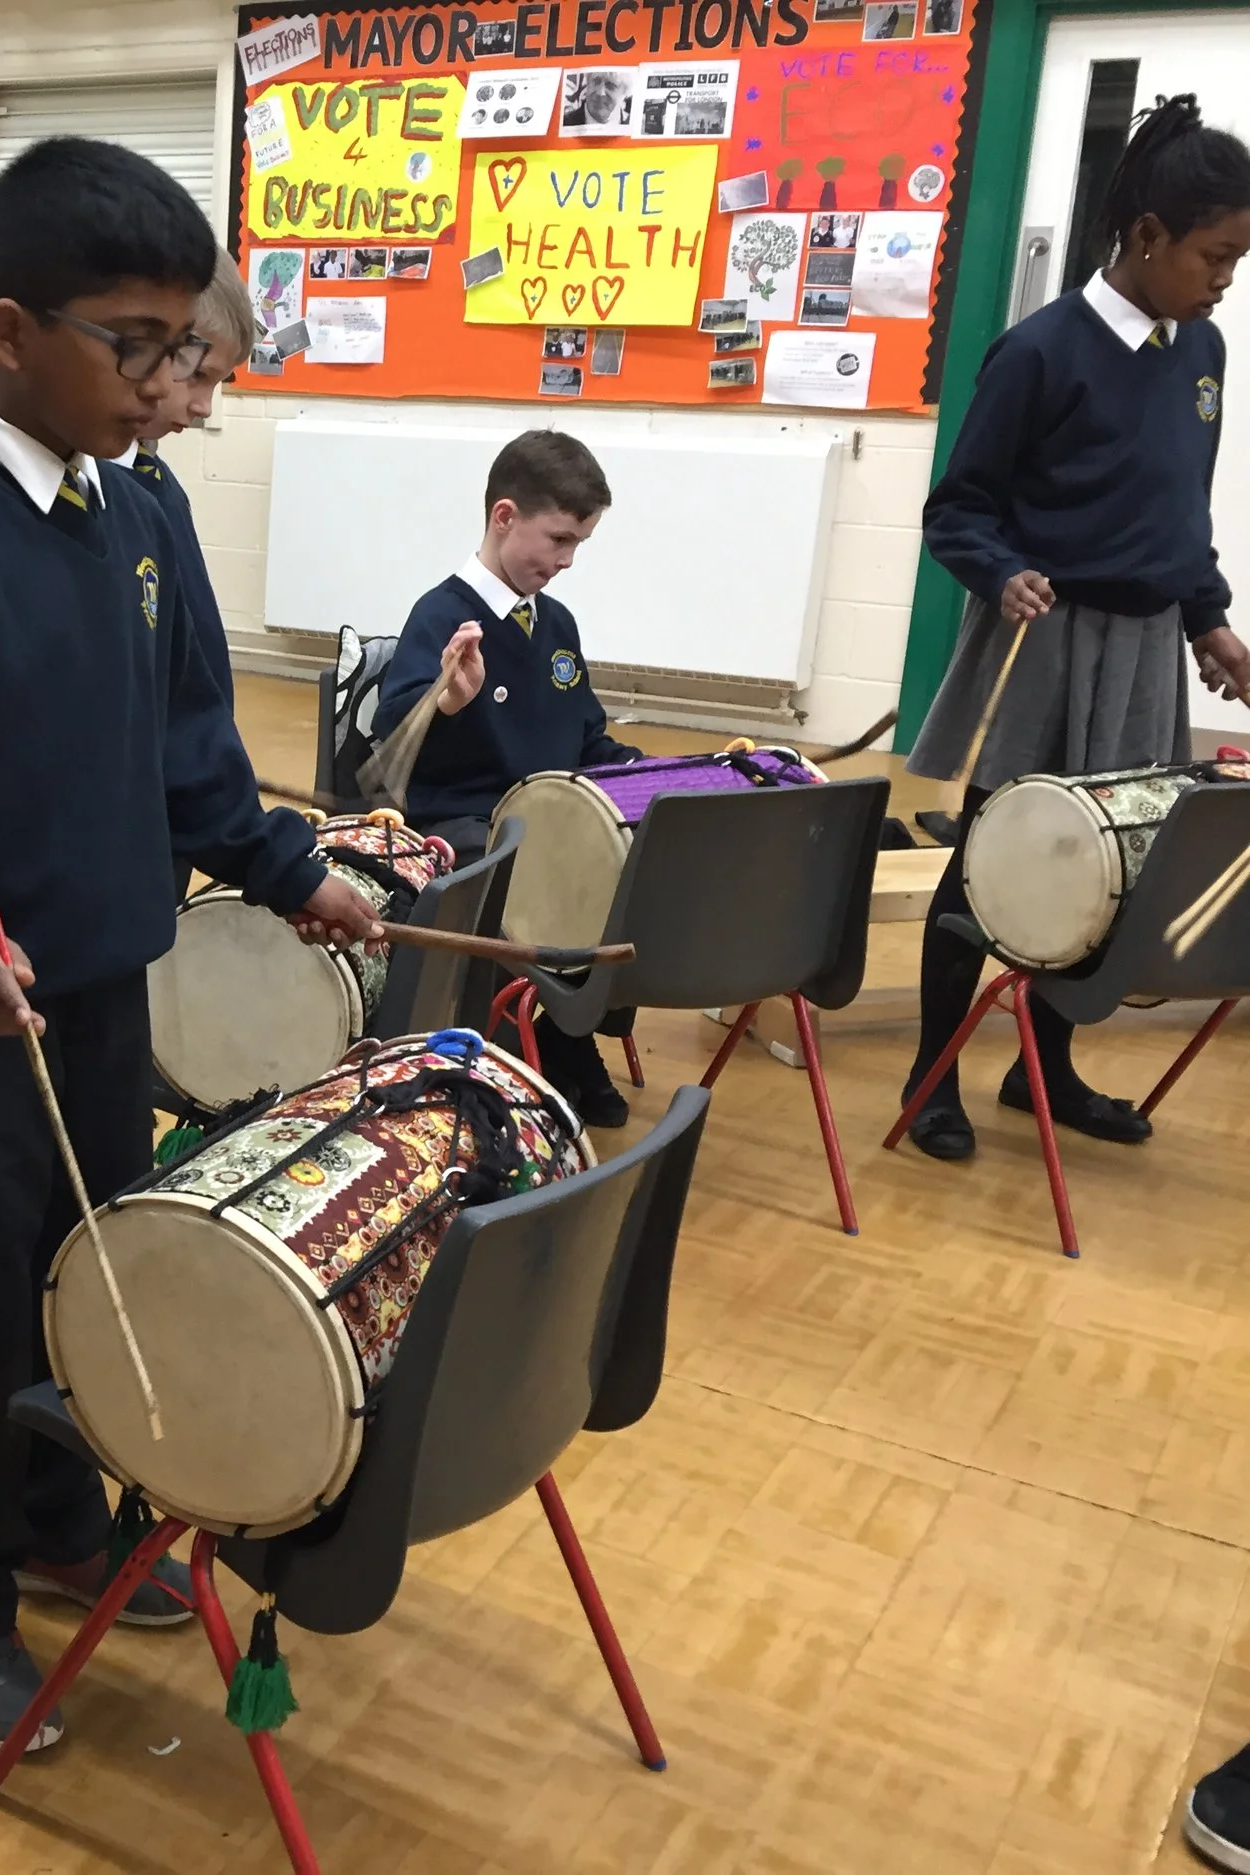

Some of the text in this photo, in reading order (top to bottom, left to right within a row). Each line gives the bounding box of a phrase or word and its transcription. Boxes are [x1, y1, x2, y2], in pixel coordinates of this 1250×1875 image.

[244, 22, 317, 75] ELECTIONS
[324, 0, 809, 69] MAYOR ELECTIONS
[781, 52, 855, 78] VOTE
[251, 123, 268, 139] FOR
[292, 82, 448, 141] VOTE
[255, 138, 283, 157] FUTURE
[343, 137, 367, 166] 4
[264, 176, 452, 234] BUSINESS
[550, 170, 665, 215] VOTE
[506, 222, 701, 269] HEALTH
